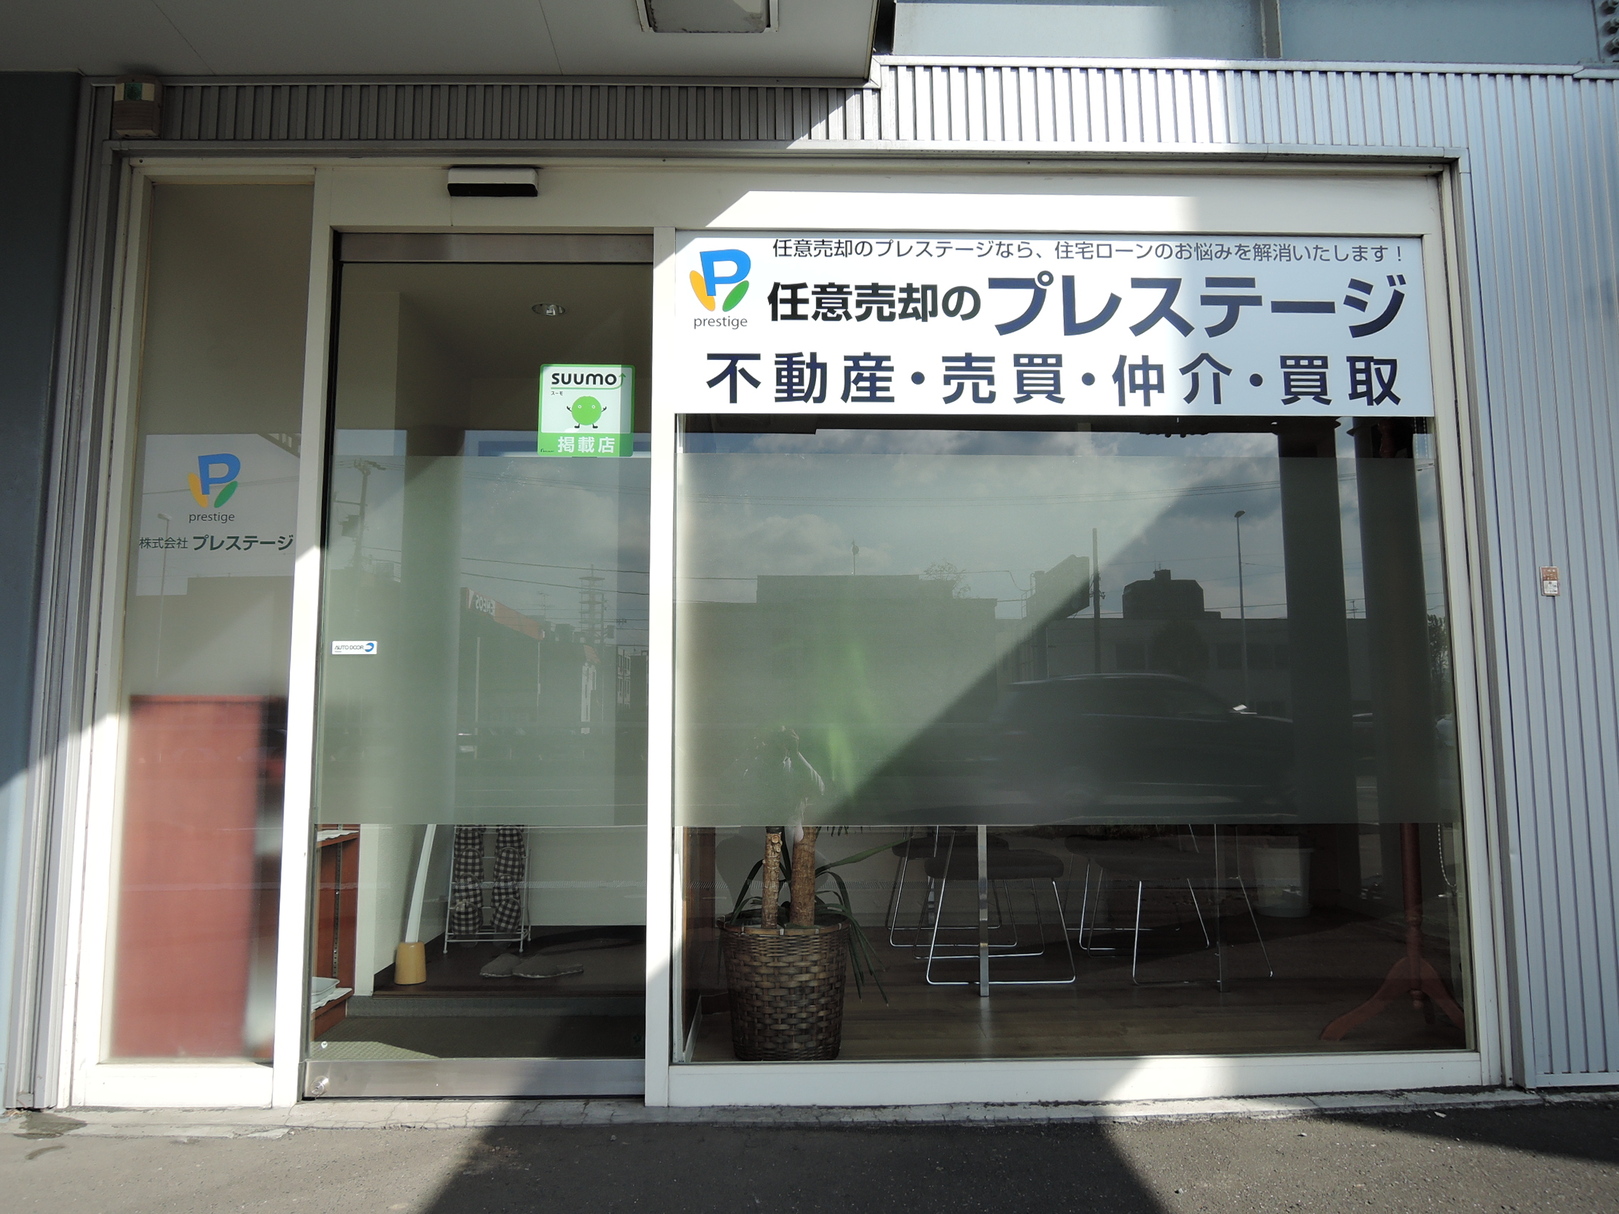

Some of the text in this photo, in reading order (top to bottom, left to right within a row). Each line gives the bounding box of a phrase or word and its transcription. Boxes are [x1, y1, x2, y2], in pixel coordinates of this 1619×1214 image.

[693, 315, 748, 330] prestige
[551, 373, 617, 385] SUUMO
[706, 351, 1402, 407] 不動産・売買・仲介・買取
[557, 436, 616, 453] 掲載店
[188, 512, 235, 524] prestige
[139, 534, 294, 551] 株式会社 プレステージ
